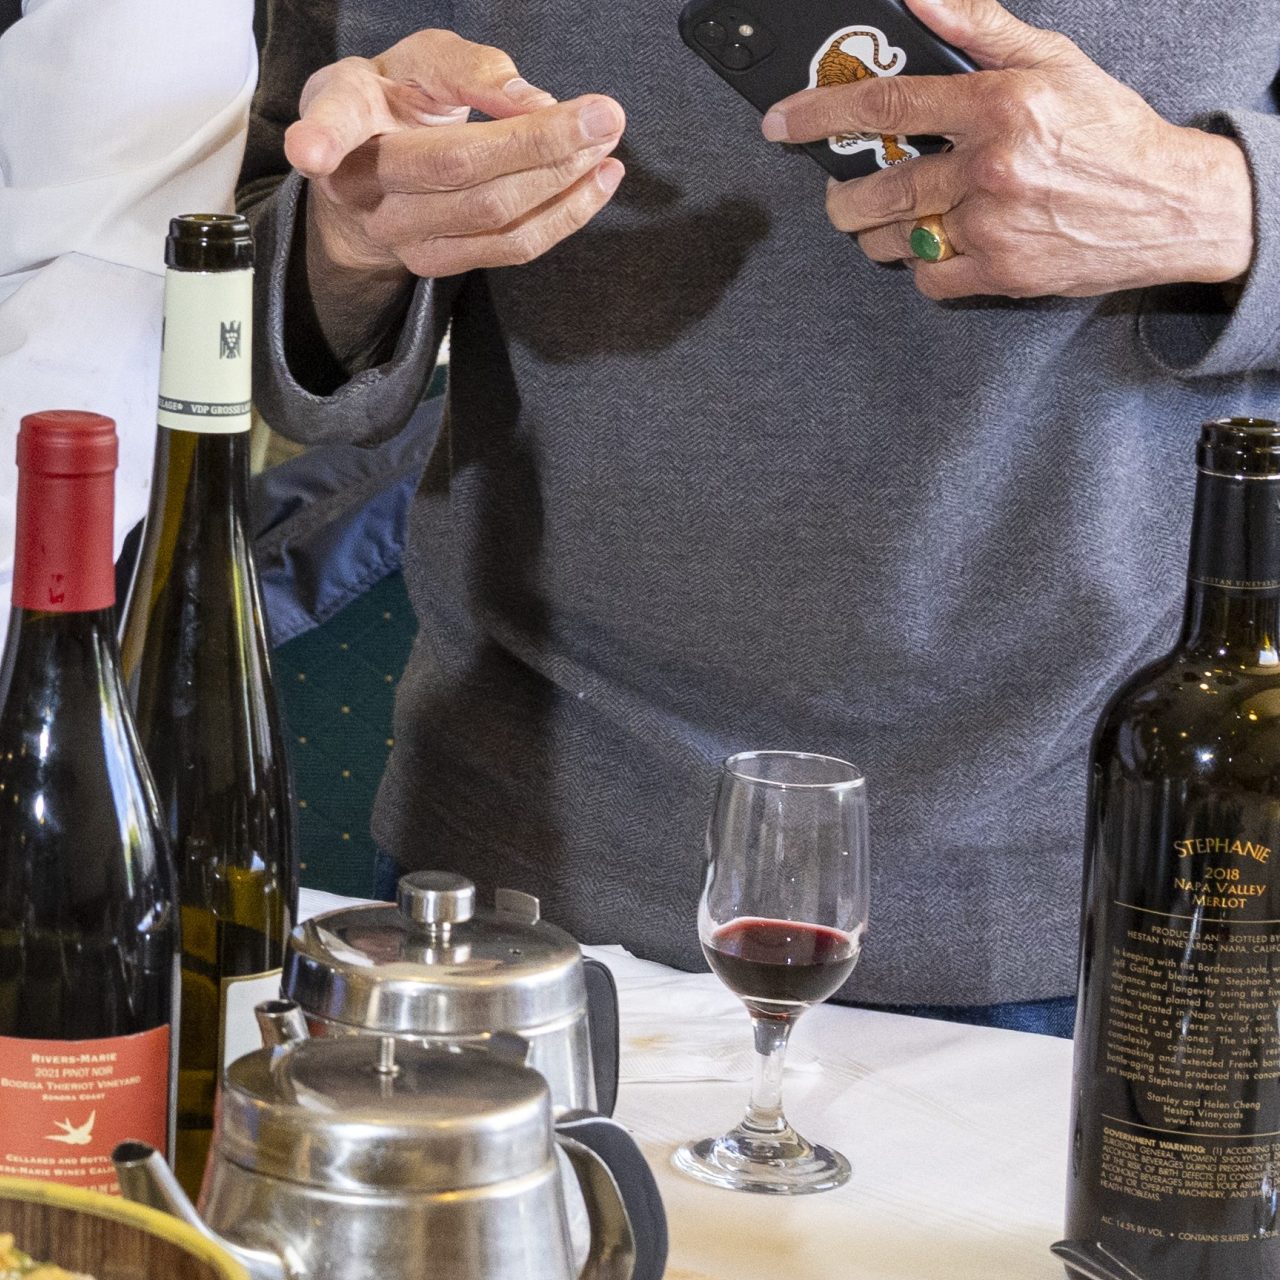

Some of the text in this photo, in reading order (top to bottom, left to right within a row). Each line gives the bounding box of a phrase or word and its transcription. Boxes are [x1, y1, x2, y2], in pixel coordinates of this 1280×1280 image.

[1173, 838, 1272, 864] STEPHANIE
[1203, 867, 1241, 881] 2018
[1127, 930, 1160, 944] HESTAN
[1151, 925, 1201, 940] PRODUCD
[1157, 958, 1176, 968] with
[1180, 961, 1195, 971] the
[1198, 962, 1243, 974] Bordeaux
[1168, 970, 1198, 984] blends
[1205, 974, 1220, 985] the
[1225, 976, 1271, 988] Stephanie
[1126, 987, 1161, 1003] varieties
[1166, 994, 1201, 1007] planted
[1205, 1000, 1215, 1008] to
[1150, 981, 1168, 991] and
[1173, 982, 1216, 999] longevity
[1220, 988, 1246, 1000] using
[1110, 1007, 1143, 1022] vineyard
[1149, 1014, 1157, 1024] is
[1162, 1019, 1169, 1027] a
[1216, 1023, 1233, 1033] mix
[1240, 1022, 1250, 1033] of
[1138, 1000, 1172, 1015] Located
[1176, 1007, 1185, 1017] in
[1190, 1010, 1216, 1022] Napa
[1220, 1012, 1253, 1024] Valley,
[1108, 1031, 1151, 1049] complexity
[1167, 1044, 1214, 1057] combined
[1231, 1048, 1251, 1057] with
[1154, 1030, 1172, 1040] and
[1219, 1035, 1237, 1045] The
[31, 1052, 118, 1065] RIVERS-MARIE
[1108, 1042, 1154, 1062] winemaking
[1159, 1055, 1177, 1064] and
[1181, 1058, 1224, 1068] extended
[1229, 1058, 1259, 1068] French
[34, 1065, 114, 1078] 2021 PINOT NOIR
[1120, 1069, 1145, 1081] supple
[1148, 1074, 1193, 1089] Stephanie
[1160, 1064, 1180, 1076] have
[1185, 1069, 1230, 1080] produced
[1234, 1070, 1250, 1080] this
[0, 1075, 141, 1091] BODEGA THIERIOT VINEYARD
[1147, 1091, 1261, 1111] Stanley and Helen Cheng
[1163, 1104, 1244, 1120] Hestan Vineyards
[1103, 1127, 1156, 1147] GOVERNMENT
[1159, 1140, 1206, 1154] WARNING:
[1212, 1146, 1223, 1156] (1)
[1226, 1144, 1270, 1155] ACCORDING
[5, 1153, 56, 1166] CELLARED
[58, 1156, 79, 1165] AND
[1141, 1155, 1184, 1169] BEVERAGES
[1185, 1161, 1218, 1172] DURING
[1219, 1162, 1263, 1173] PREGNANCY
[1181, 1152, 1218, 1164] WOMEN
[1221, 1154, 1253, 1164] SHOULD
[1140, 1181, 1174, 1195] OPERATE
[1230, 1190, 1249, 1199] AND
[1141, 1172, 1184, 1187] BEVERAGES
[1216, 1181, 1239, 1190] YOUR
[1137, 1224, 1146, 1233] BY
[1178, 1231, 1218, 1242] CONTAINS
